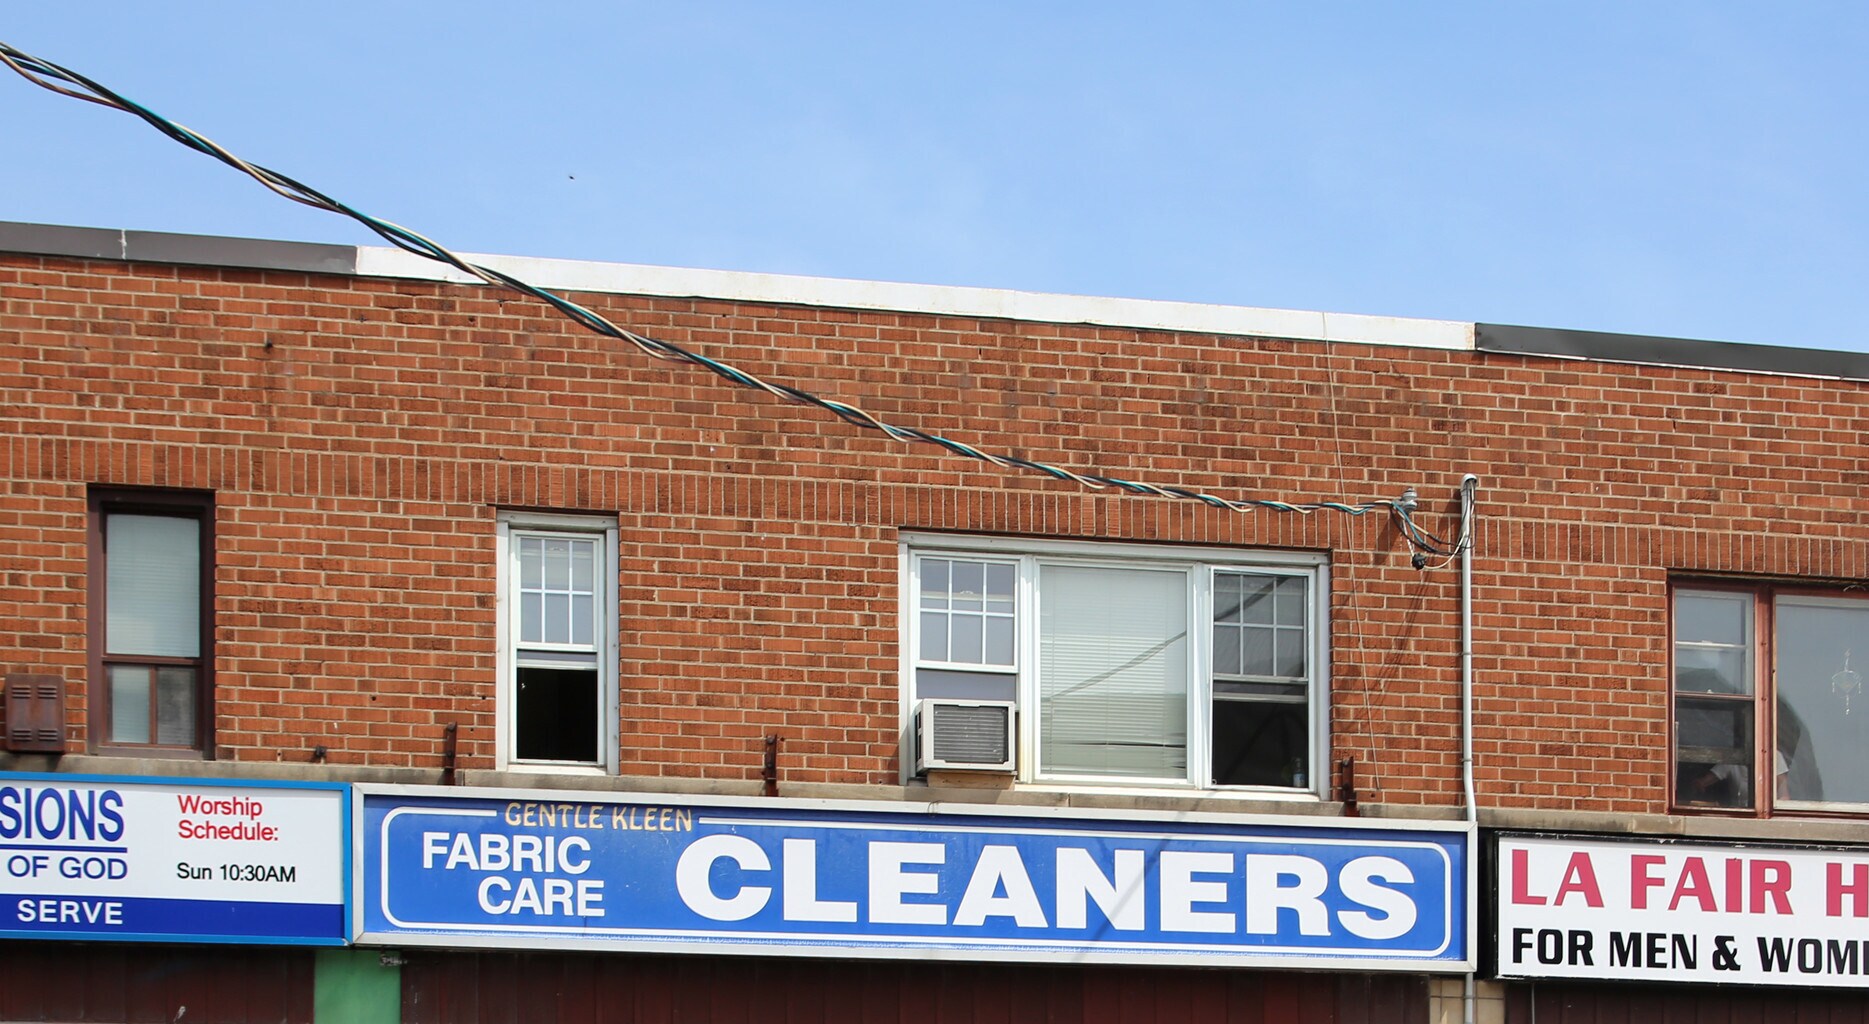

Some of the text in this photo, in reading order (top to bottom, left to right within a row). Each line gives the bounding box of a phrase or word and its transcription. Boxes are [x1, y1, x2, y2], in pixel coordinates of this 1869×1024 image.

[0, 787, 125, 842] SIONS
[178, 795, 263, 820] Worship
[505, 802, 692, 832] GENTLE KLEEN
[178, 820, 279, 841] Schedule:
[8, 855, 128, 880] OF GOD
[422, 832, 592, 875] FABRIC
[176, 862, 296, 883] Sun 10:30AM
[676, 834, 1418, 940] CLEANERS
[1512, 849, 1604, 908] LA
[1631, 854, 1794, 915] FAIR
[17, 899, 123, 925] SERVE
[477, 876, 605, 917] CARE
[1512, 927, 1594, 966] FOR
[1609, 931, 1697, 970] MEN
[1712, 935, 1741, 972] &
